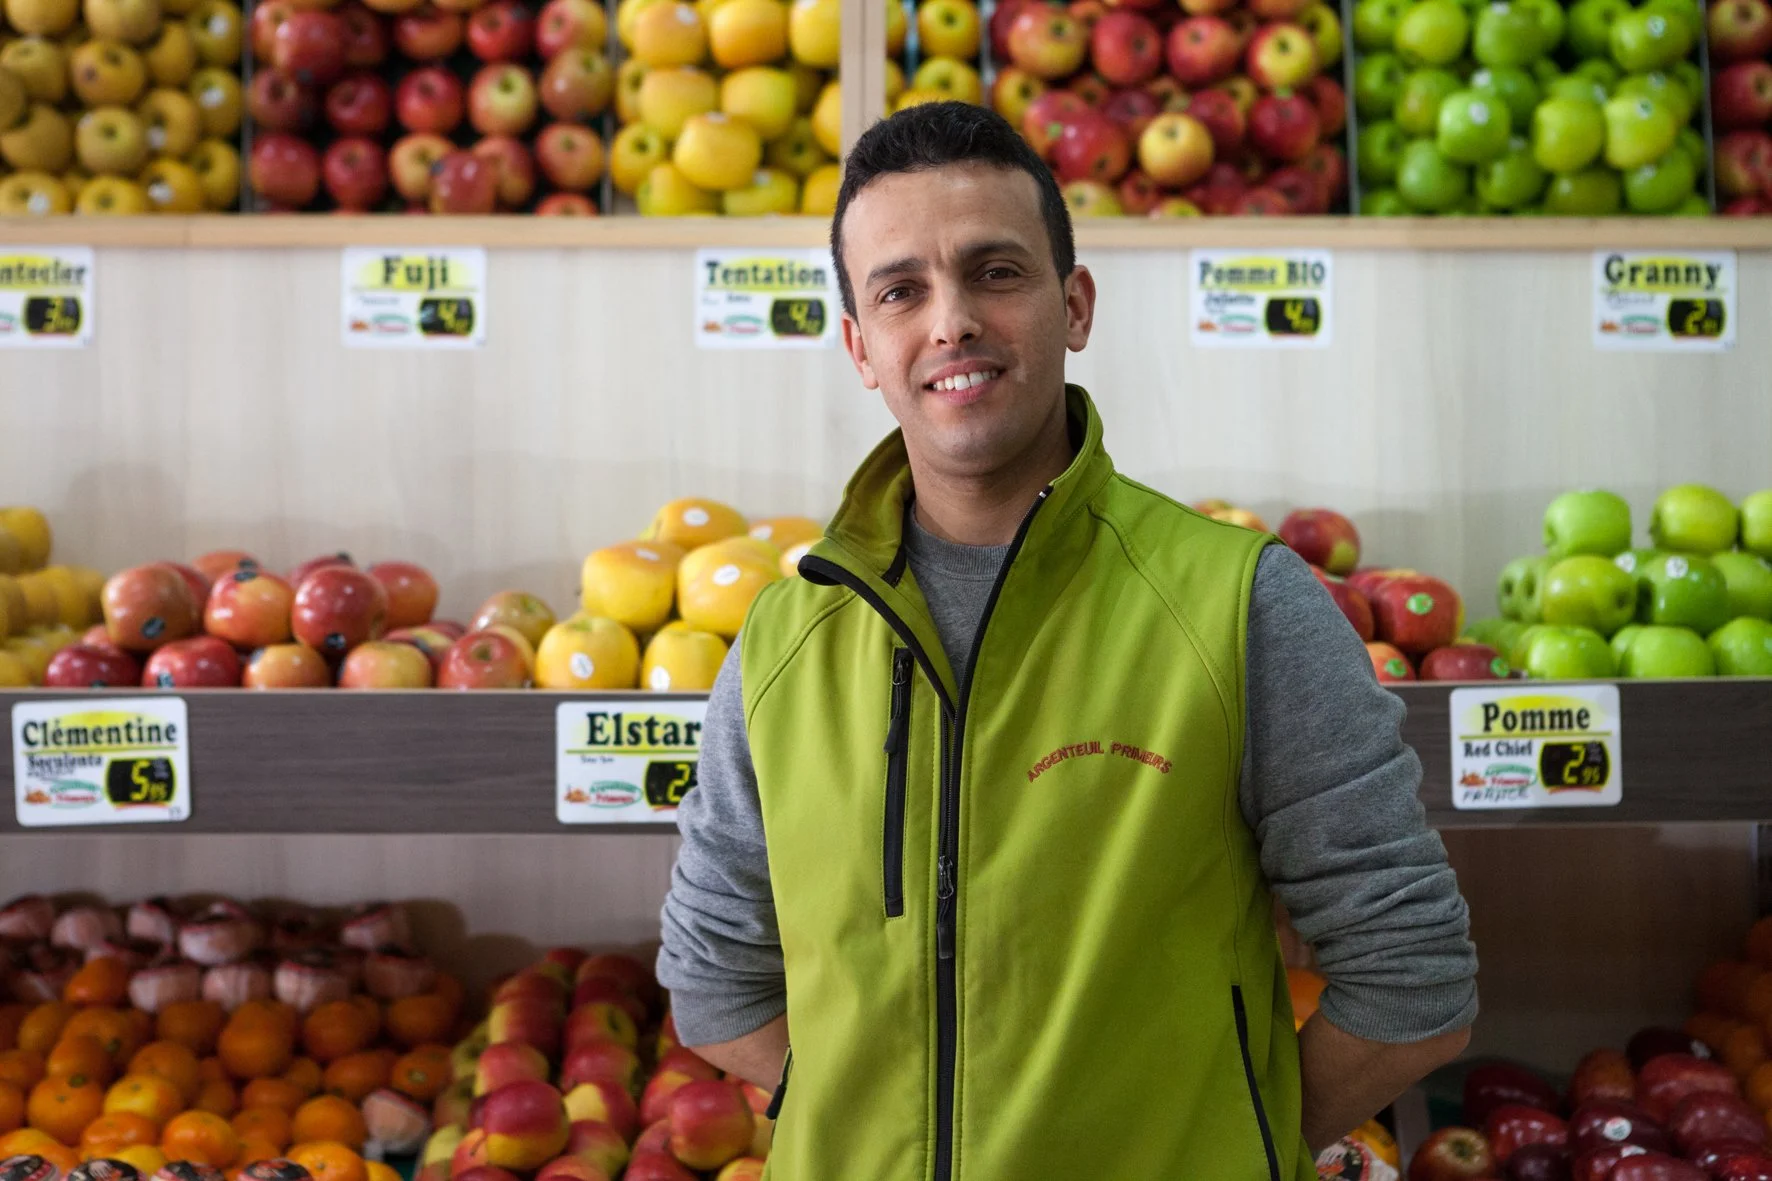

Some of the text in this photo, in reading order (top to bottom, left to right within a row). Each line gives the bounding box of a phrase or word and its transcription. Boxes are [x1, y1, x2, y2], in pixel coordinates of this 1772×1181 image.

[383, 255, 449, 291] Fuji
[705, 259, 827, 286] Tentation
[1199, 260, 1278, 286] Pomme
[1604, 253, 1723, 291] Granny
[22, 715, 178, 747] Clémentine
[586, 712, 702, 747] Elstar
[1481, 702, 1591, 733] Pomme
[1026, 740, 1105, 783] ARGENTEUIL
[1463, 740, 1533, 758] Red Chief
